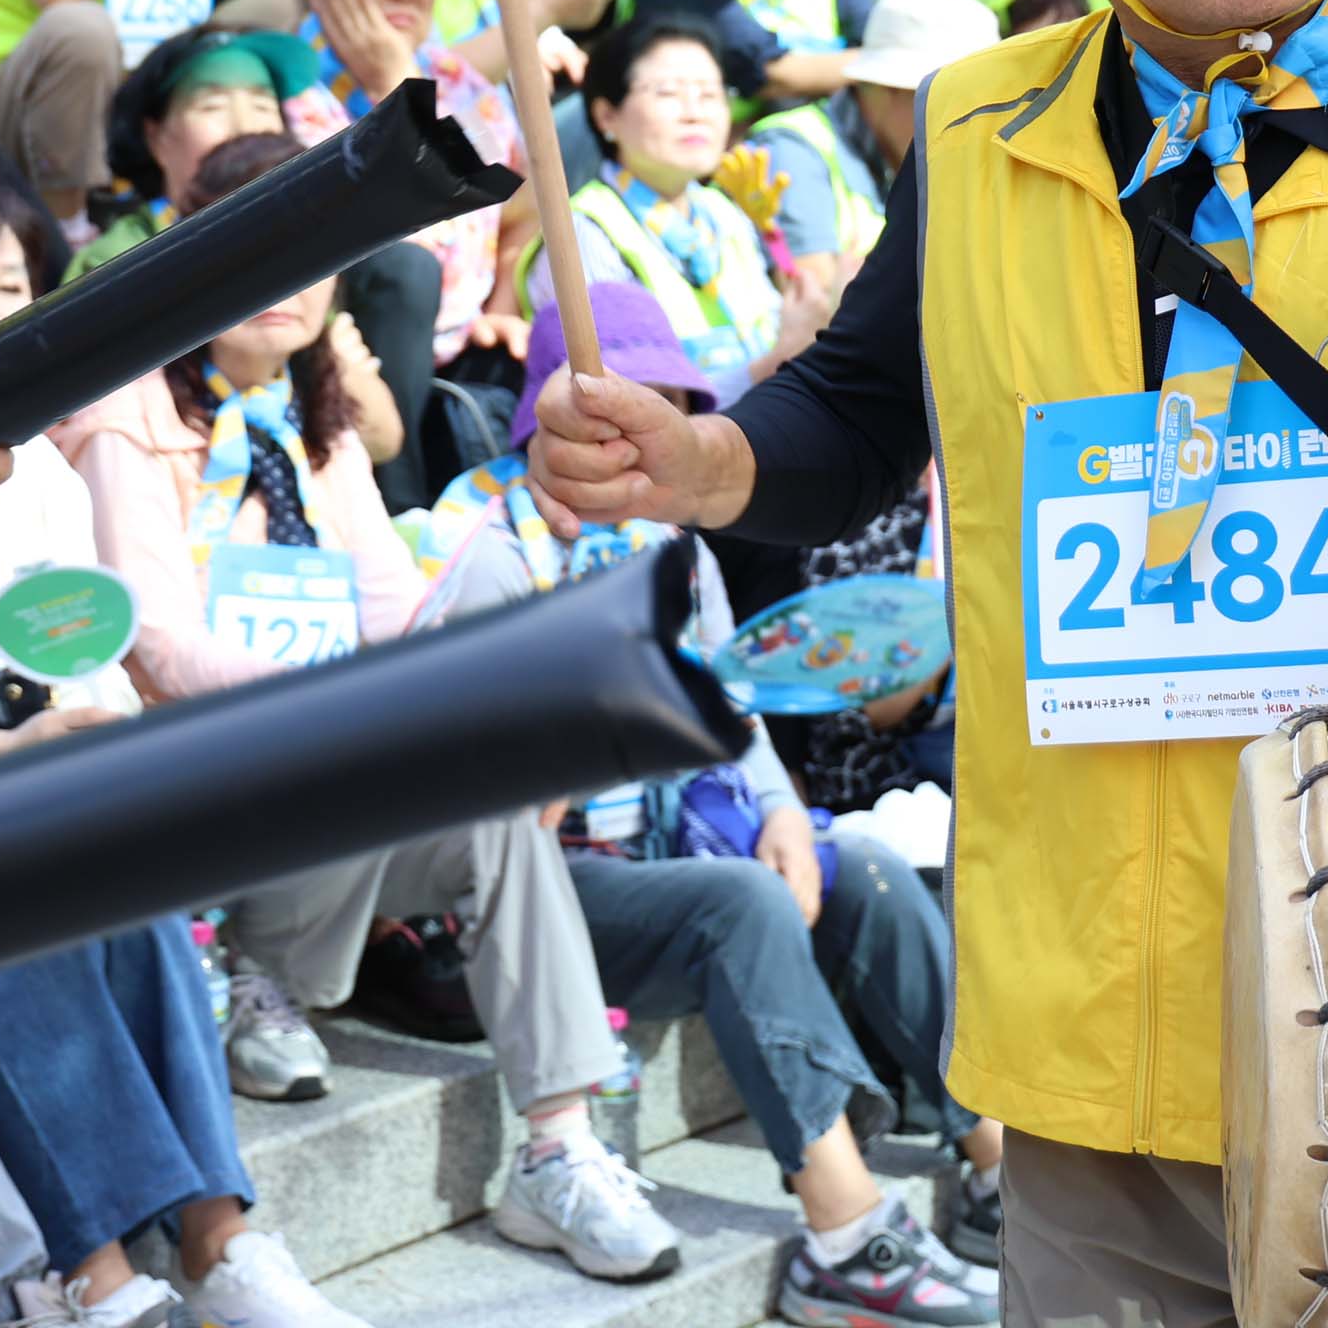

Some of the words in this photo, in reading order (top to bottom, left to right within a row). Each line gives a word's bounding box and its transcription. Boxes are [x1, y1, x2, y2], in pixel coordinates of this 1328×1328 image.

[1207, 690, 1256, 702] netmarble
[1061, 696, 1151, 712] 서울특별시구로구상공회
[1266, 703, 1294, 716] KIBA
